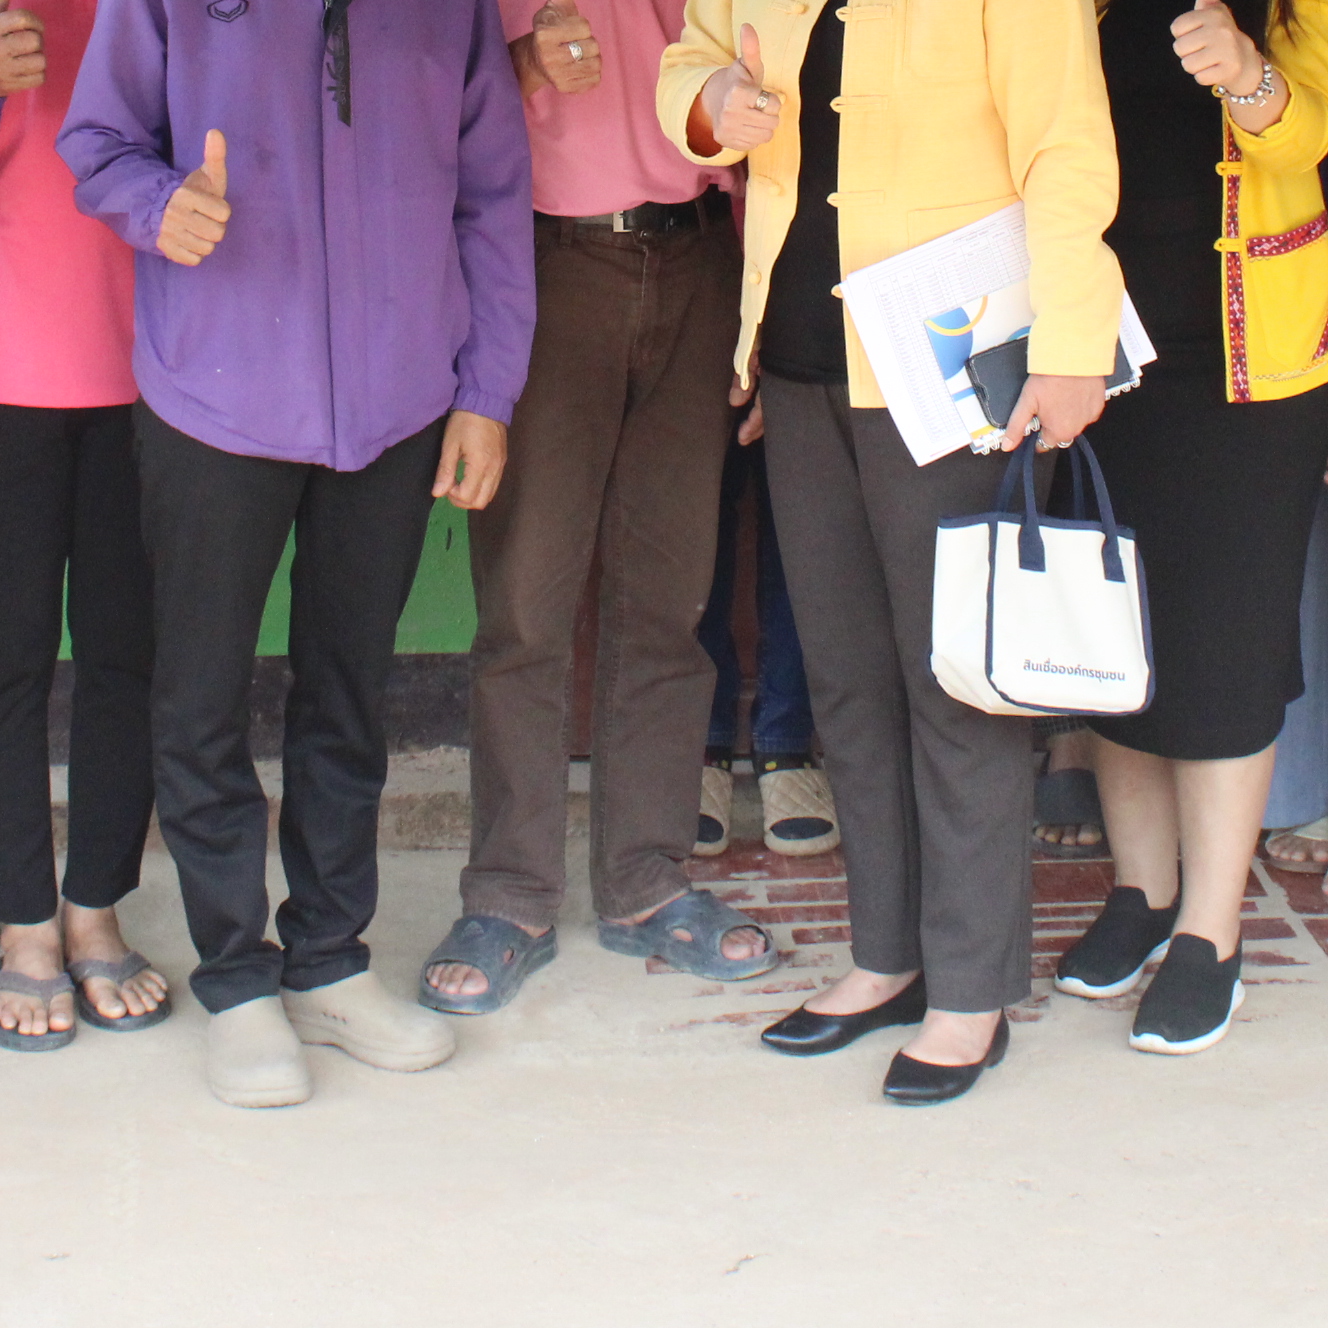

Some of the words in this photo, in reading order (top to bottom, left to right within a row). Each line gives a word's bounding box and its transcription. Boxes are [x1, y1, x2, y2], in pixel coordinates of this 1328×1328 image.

[1022, 657, 1126, 683] สินเชื่อองค์กรชุมชน
